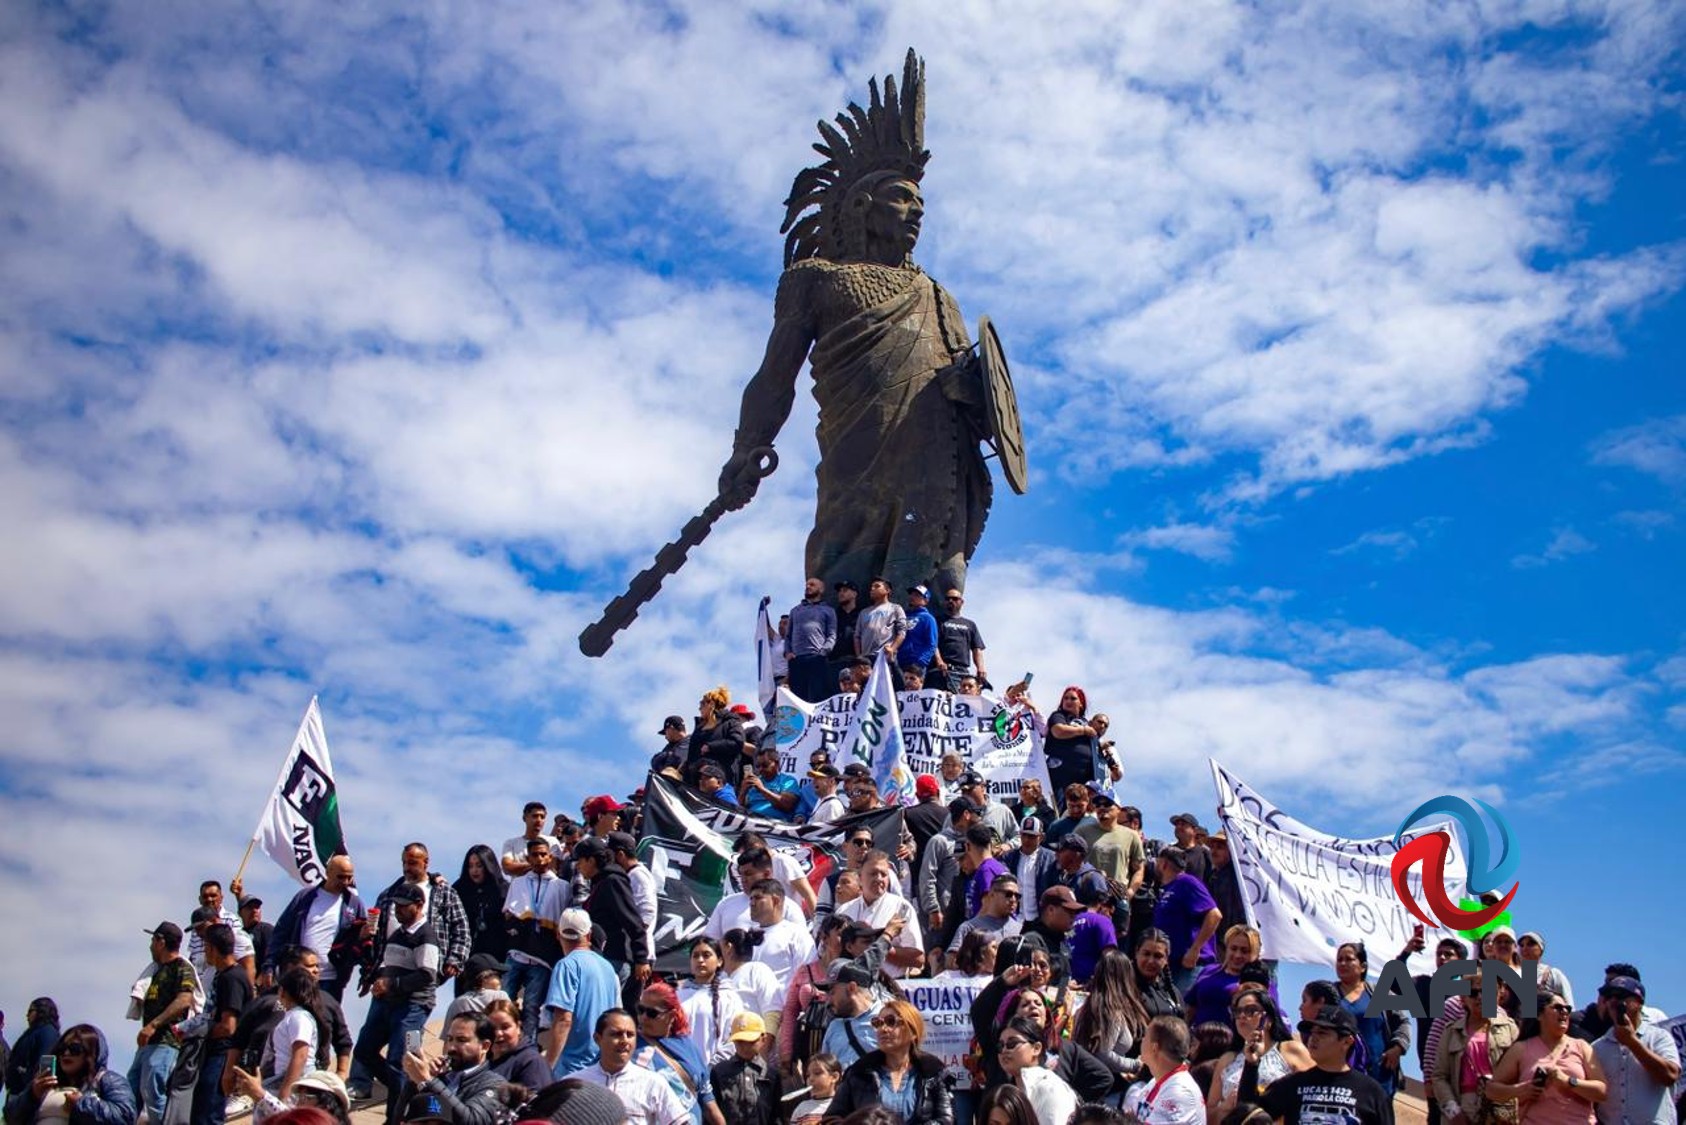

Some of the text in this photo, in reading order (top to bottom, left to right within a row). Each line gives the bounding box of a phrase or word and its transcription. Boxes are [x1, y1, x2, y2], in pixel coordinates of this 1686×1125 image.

[921, 694, 974, 719] vida
[808, 714, 840, 728] para
[986, 779, 1025, 795] Famil
